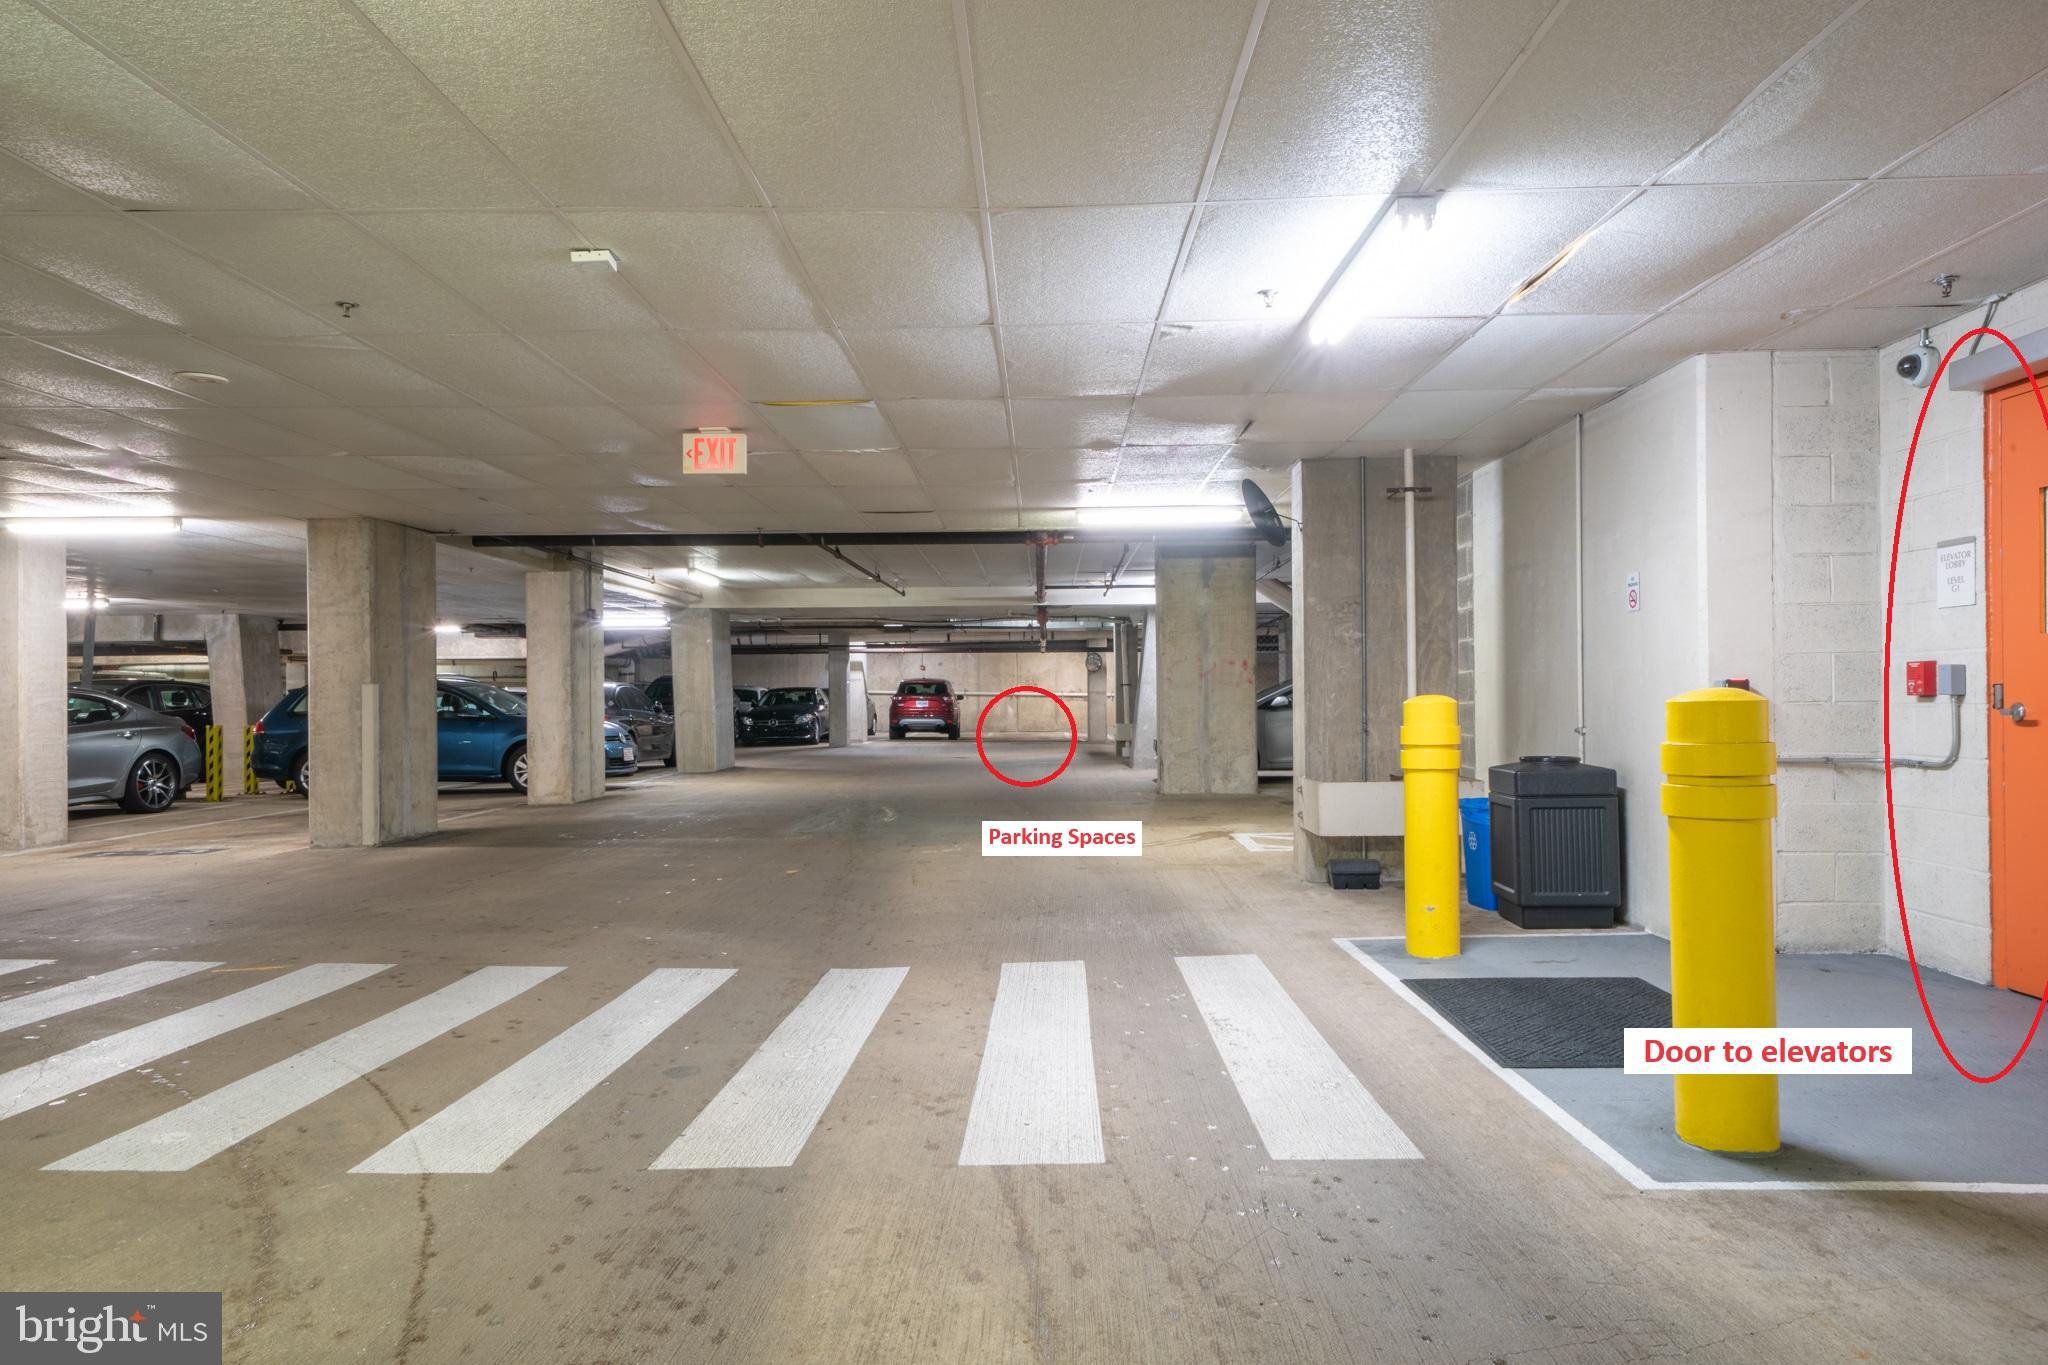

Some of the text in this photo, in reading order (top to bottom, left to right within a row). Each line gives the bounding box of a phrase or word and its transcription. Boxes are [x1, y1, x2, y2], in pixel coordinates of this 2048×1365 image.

[694, 437, 737, 470] EXIT
[1940, 550, 1972, 563] ELEVATOR
[1945, 560, 1966, 570] LOBBY
[1947, 576, 1965, 585] LEVEL
